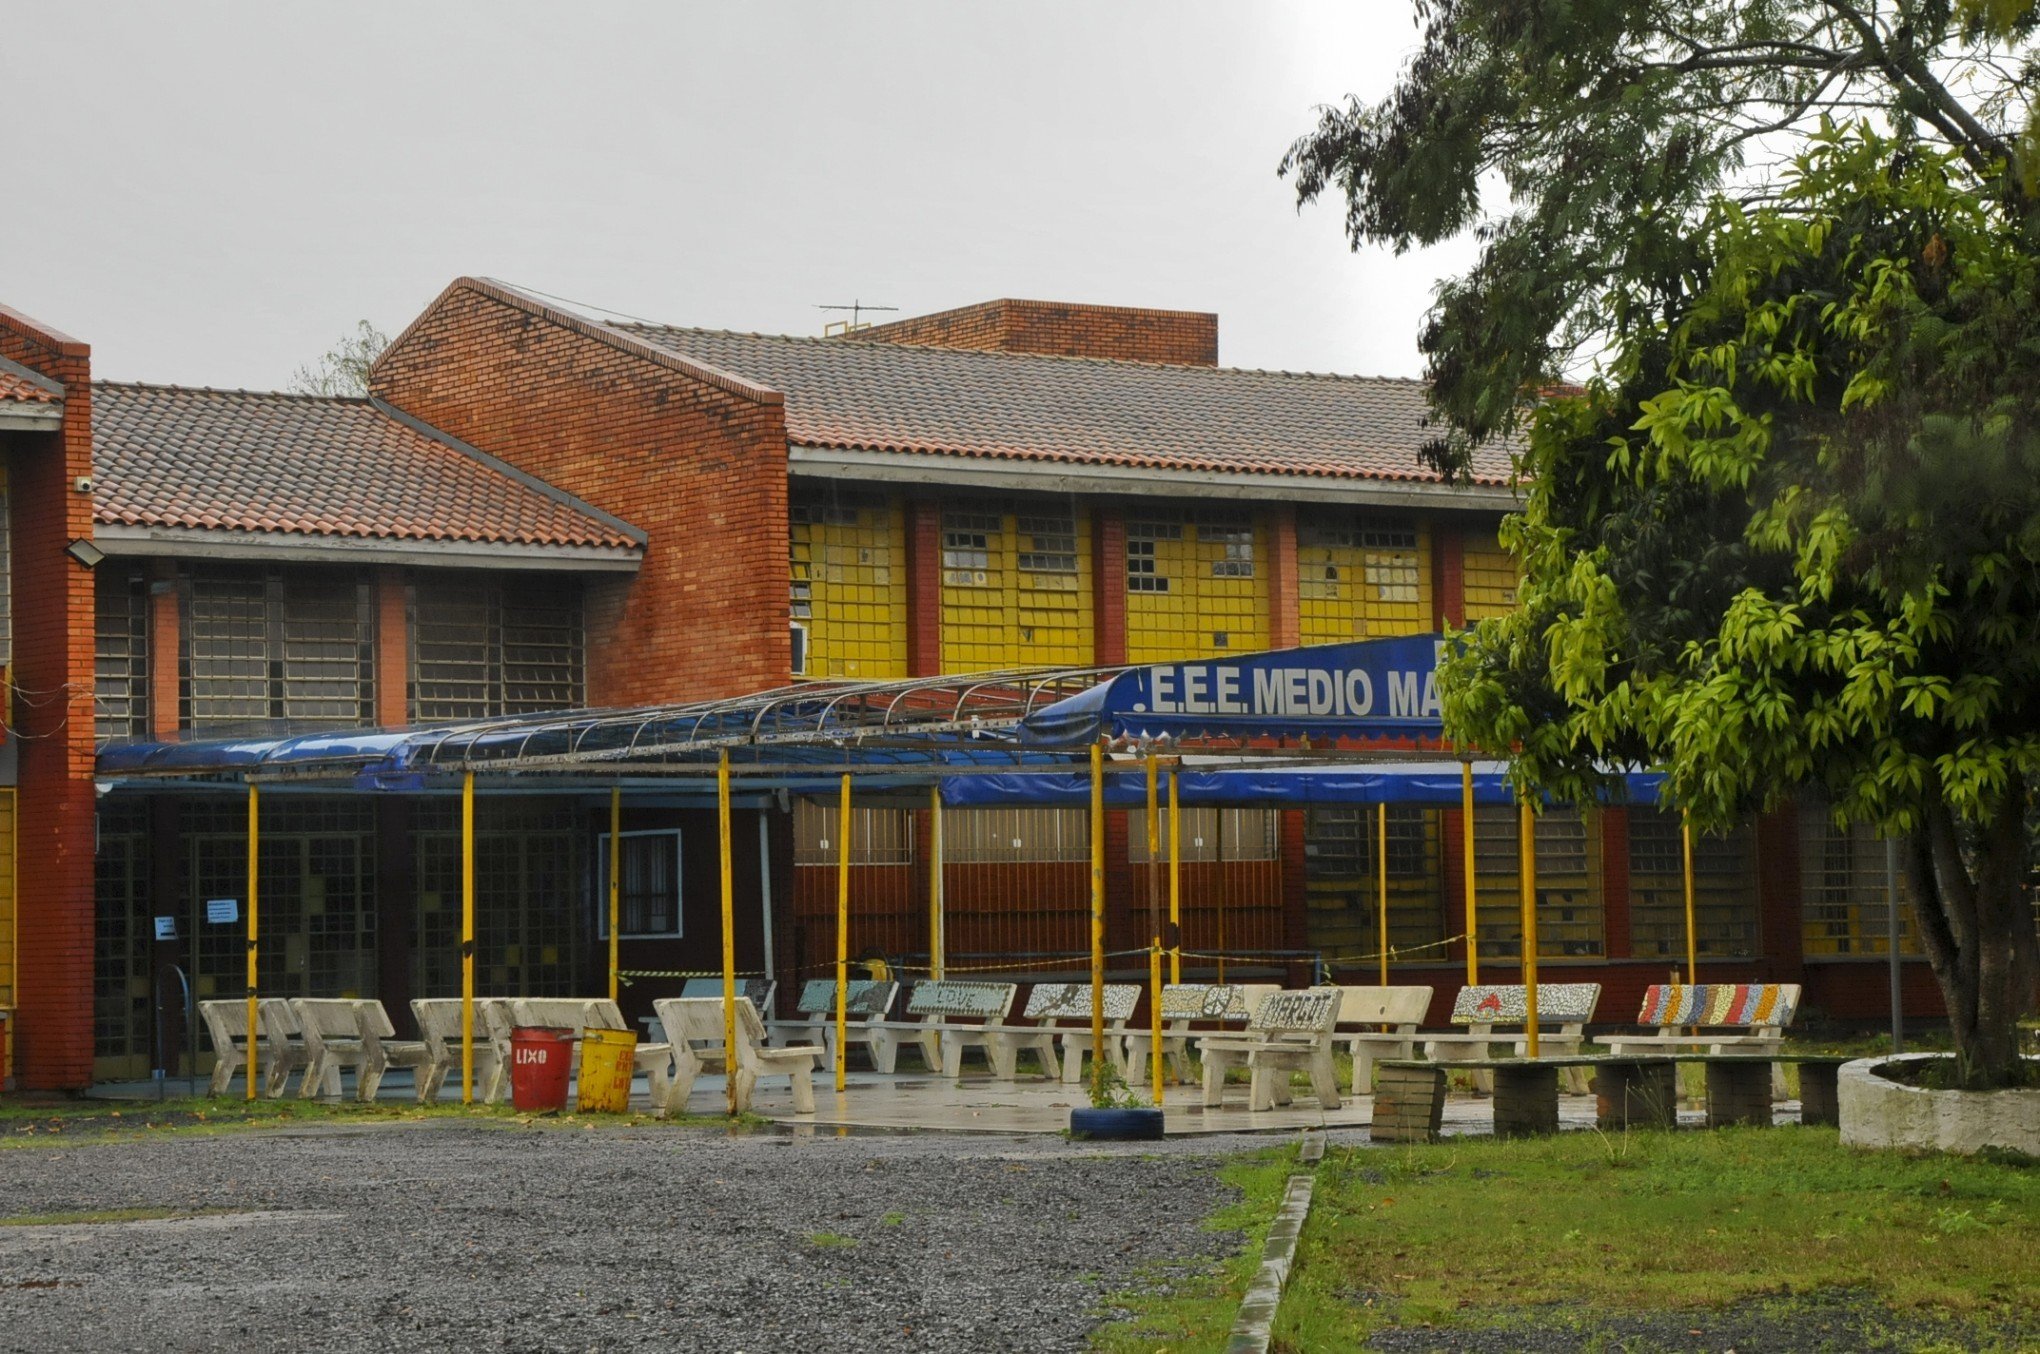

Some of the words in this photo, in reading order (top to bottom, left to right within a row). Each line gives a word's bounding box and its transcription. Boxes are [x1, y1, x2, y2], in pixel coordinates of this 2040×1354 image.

[1253, 668, 1373, 716] MEDIO
[937, 989, 976, 1008] LOVE
[516, 1048, 547, 1064] LIXO
